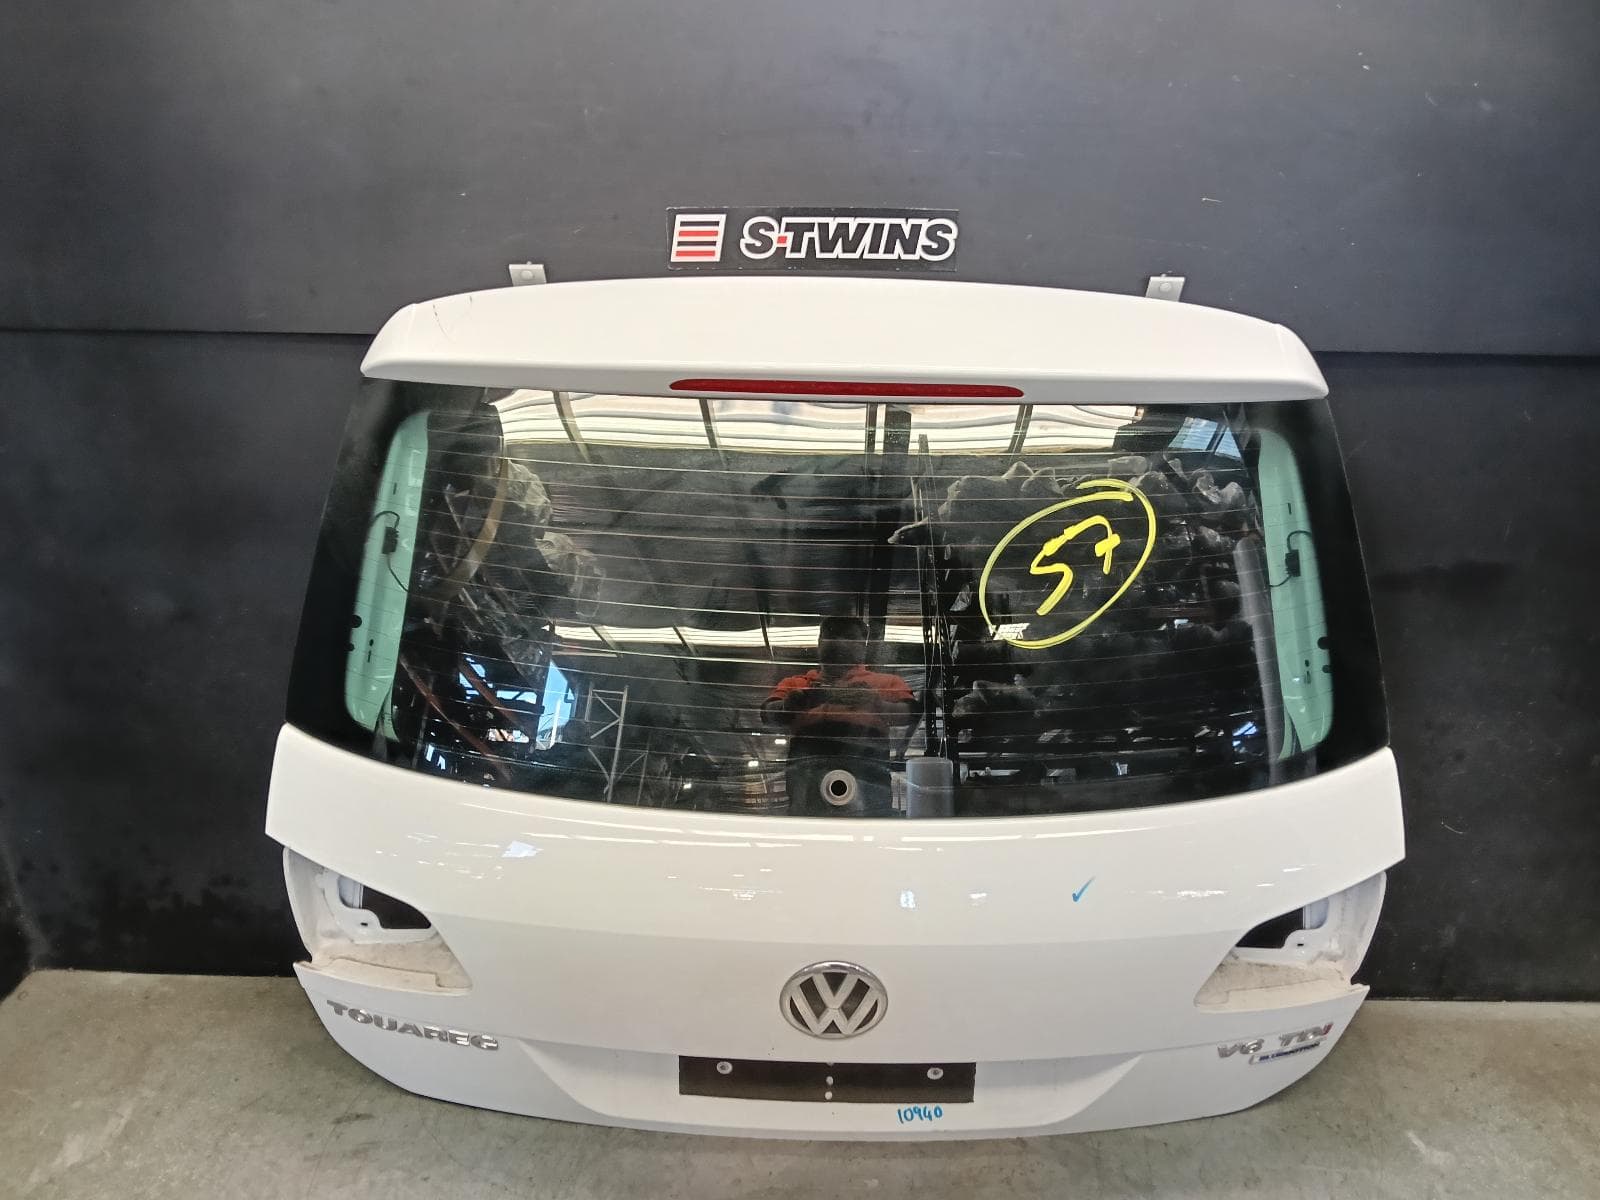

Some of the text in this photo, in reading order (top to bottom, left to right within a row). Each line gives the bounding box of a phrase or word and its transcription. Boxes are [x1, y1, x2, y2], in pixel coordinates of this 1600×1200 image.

[1030, 515, 1121, 616] 57
[327, 1000, 499, 1050] TOUAREG
[1217, 1038, 1264, 1058] V6
[897, 1105, 943, 1124] 10940
